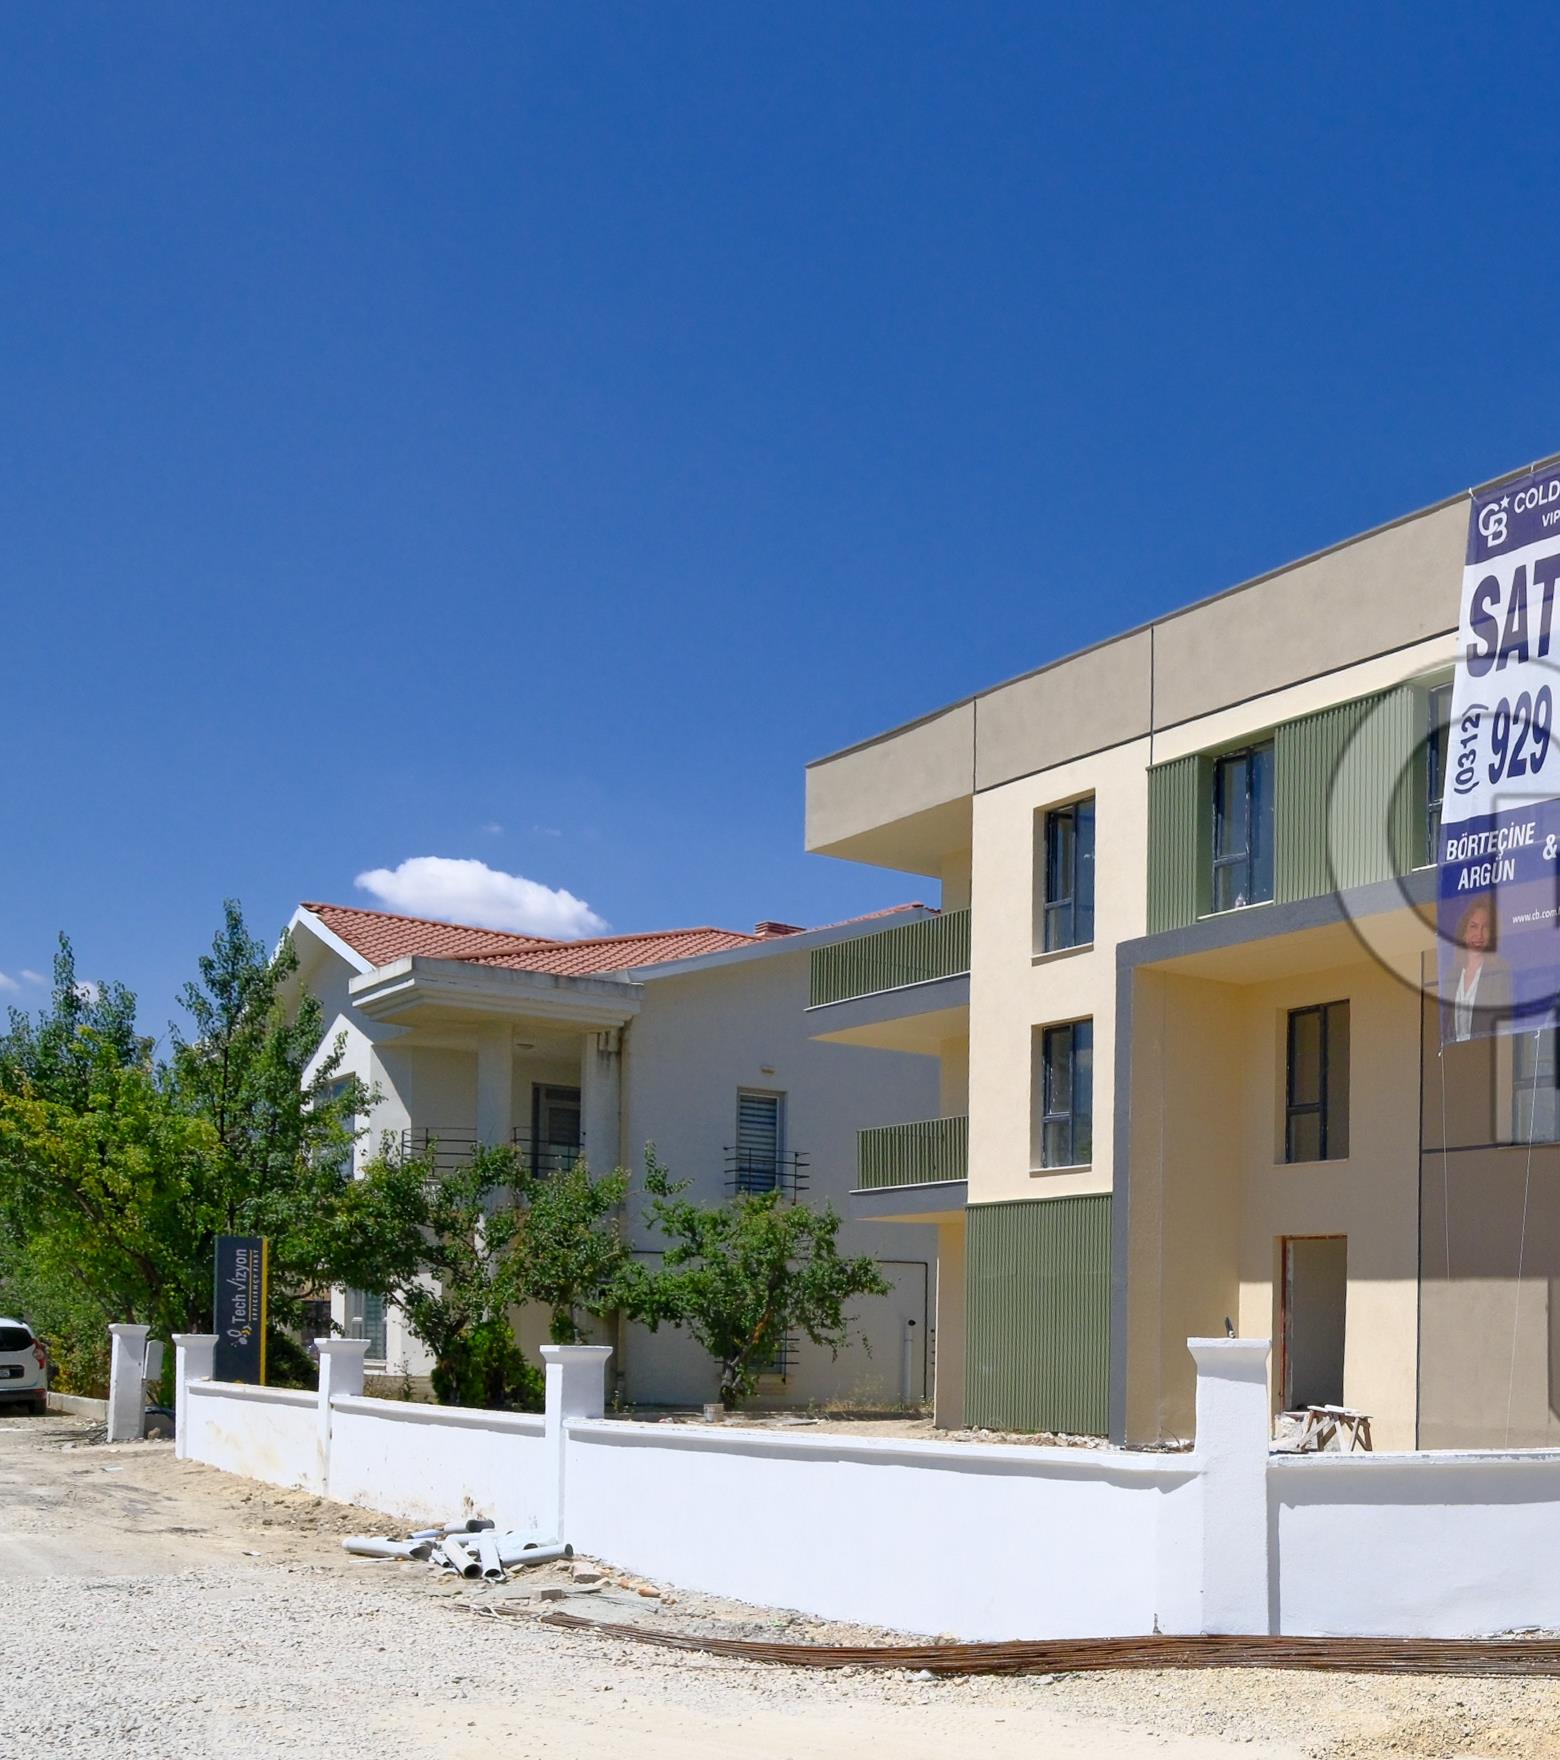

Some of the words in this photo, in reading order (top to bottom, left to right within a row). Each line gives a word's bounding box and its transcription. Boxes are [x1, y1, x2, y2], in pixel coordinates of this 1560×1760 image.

[1454, 703, 1489, 794] (0312)
[1488, 684, 1553, 785] 929
[1446, 822, 1536, 861] BÖRTEÇİNE
[1542, 834, 1558, 861] &
[1457, 857, 1515, 890] ARGÜN
[231, 1294, 247, 1325] Tech
